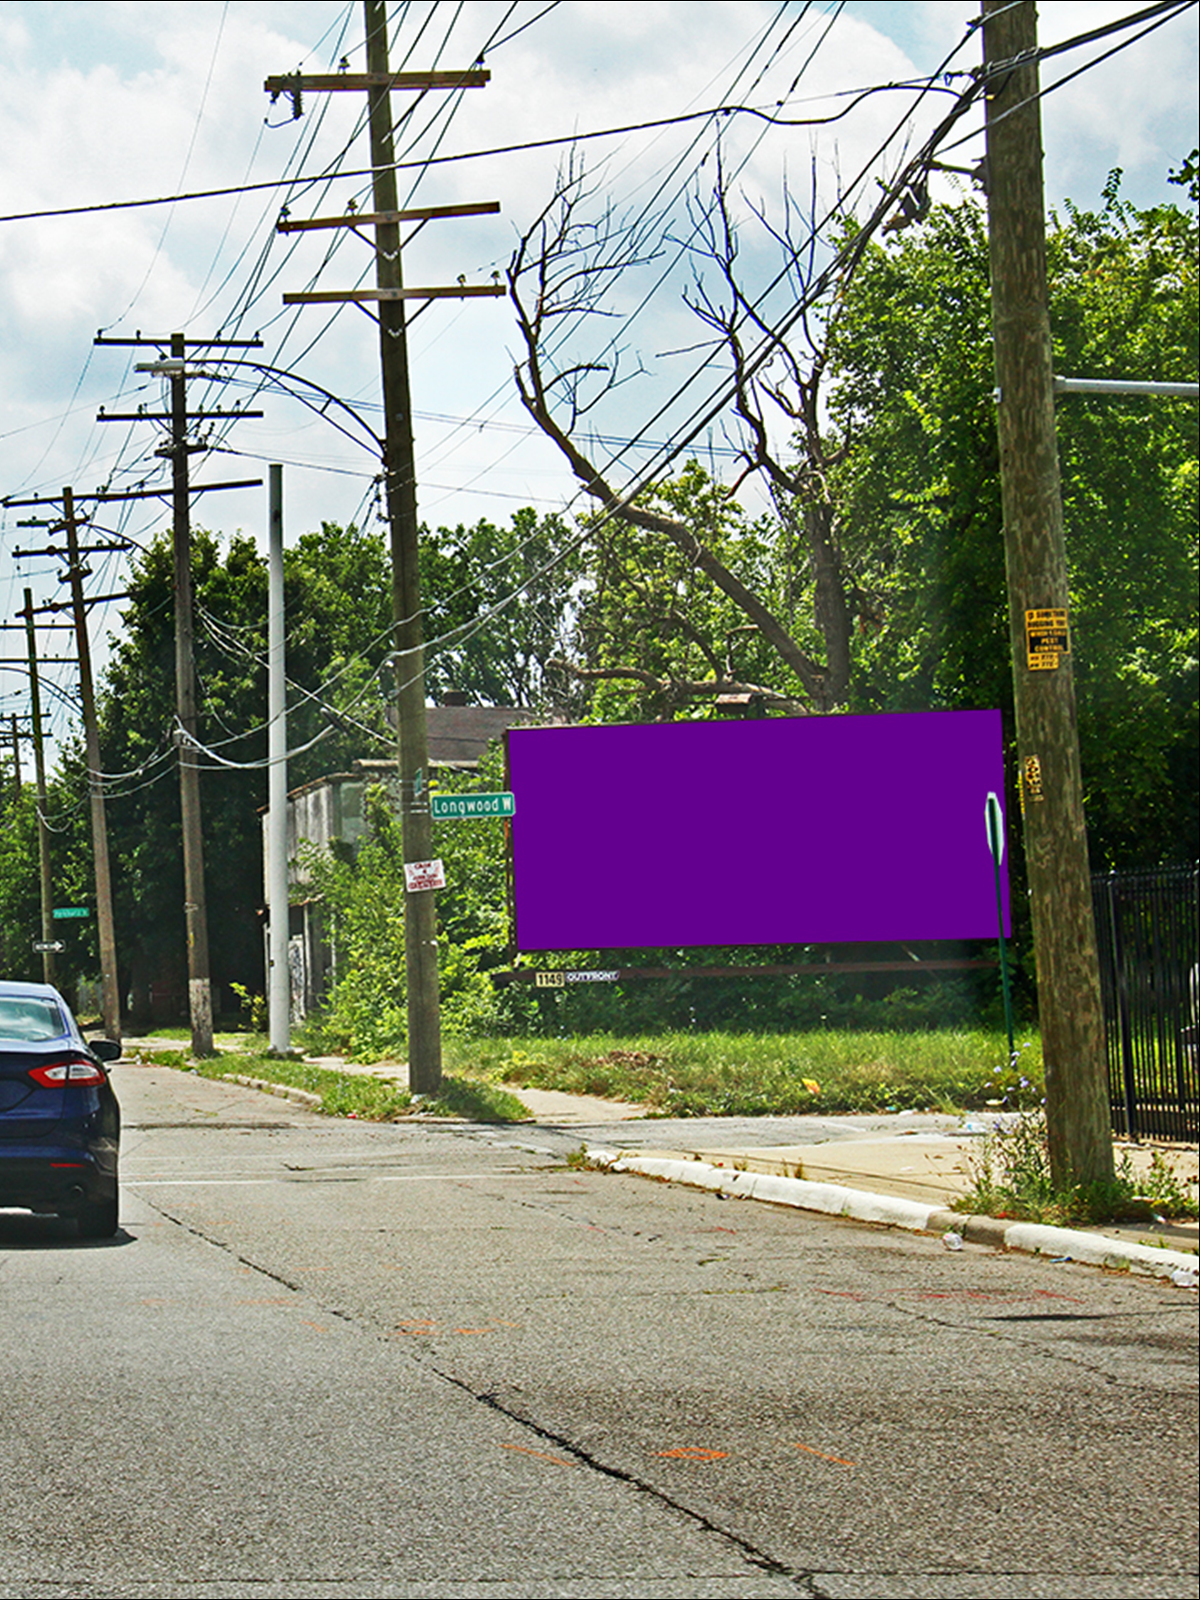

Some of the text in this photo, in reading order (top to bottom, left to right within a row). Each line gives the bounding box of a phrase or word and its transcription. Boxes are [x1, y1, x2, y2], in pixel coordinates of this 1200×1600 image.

[434, 796, 513, 815] Longwood W
[538, 973, 563, 985] 1149
